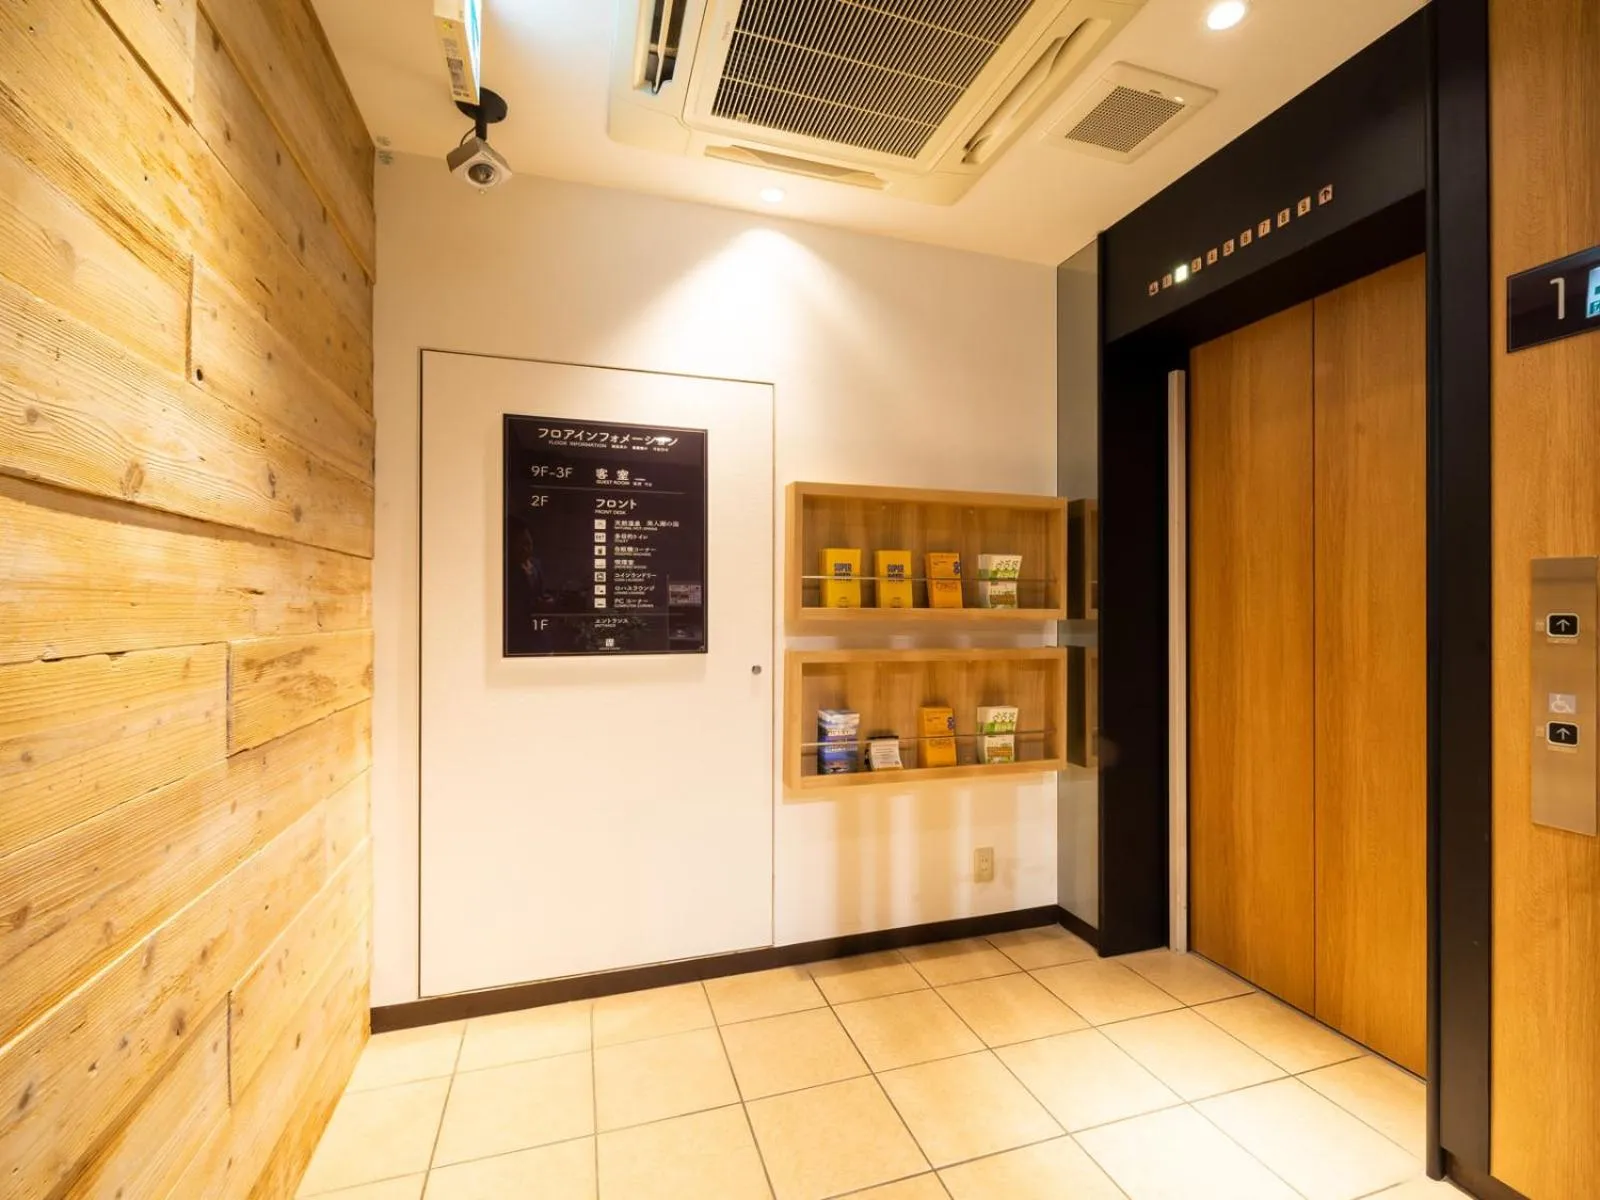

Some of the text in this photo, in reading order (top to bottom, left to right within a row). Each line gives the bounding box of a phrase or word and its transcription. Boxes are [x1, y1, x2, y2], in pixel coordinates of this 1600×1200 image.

[1549, 277, 1566, 320] 1
[531, 465, 574, 479] 9F-3F
[531, 495, 549, 507] 2F
[595, 498, 637, 510] フロント
[532, 619, 549, 631] 1F
